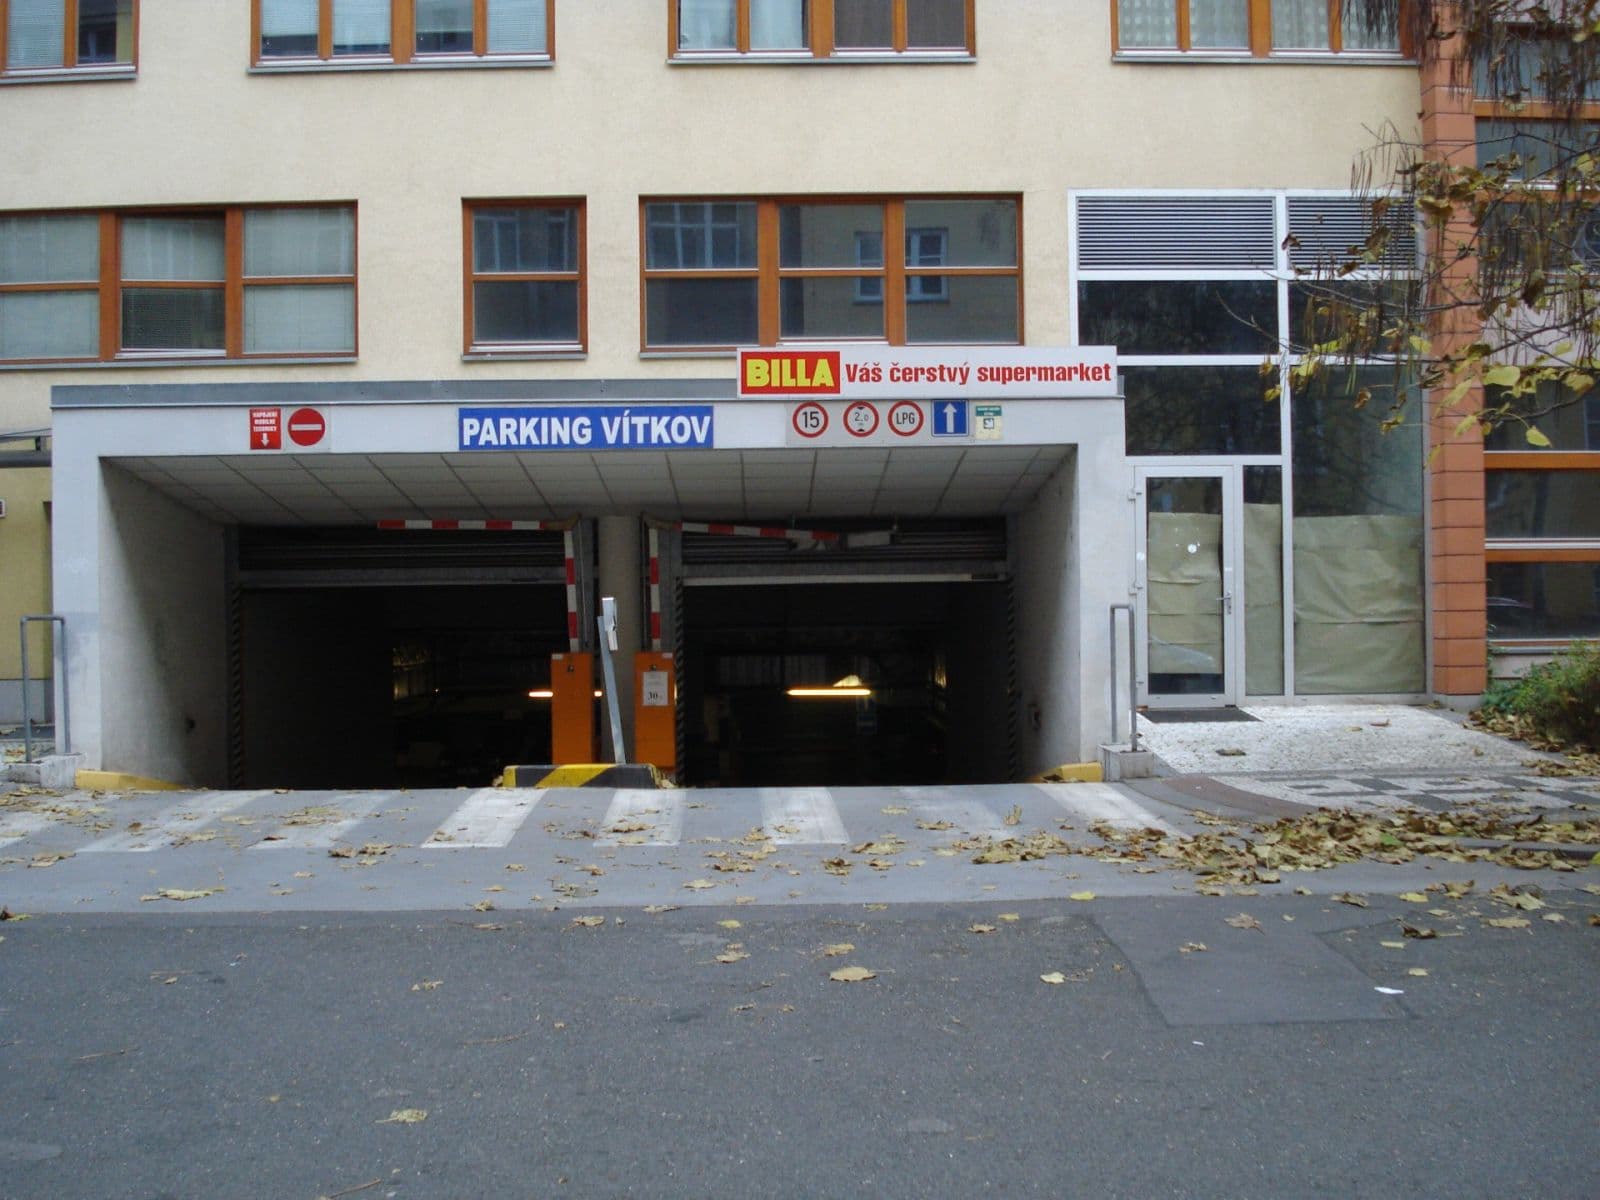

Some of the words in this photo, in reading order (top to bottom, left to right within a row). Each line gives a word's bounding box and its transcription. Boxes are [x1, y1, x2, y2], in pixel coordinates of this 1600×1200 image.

[746, 358, 835, 388] BILLA
[845, 361, 883, 384] Váš
[889, 361, 969, 386] čerstvý
[977, 362, 1111, 385] supermarket
[463, 416, 593, 446] PARKING
[600, 409, 711, 445] VÍTKOV
[802, 411, 820, 428] 15
[896, 411, 915, 425] LPG
